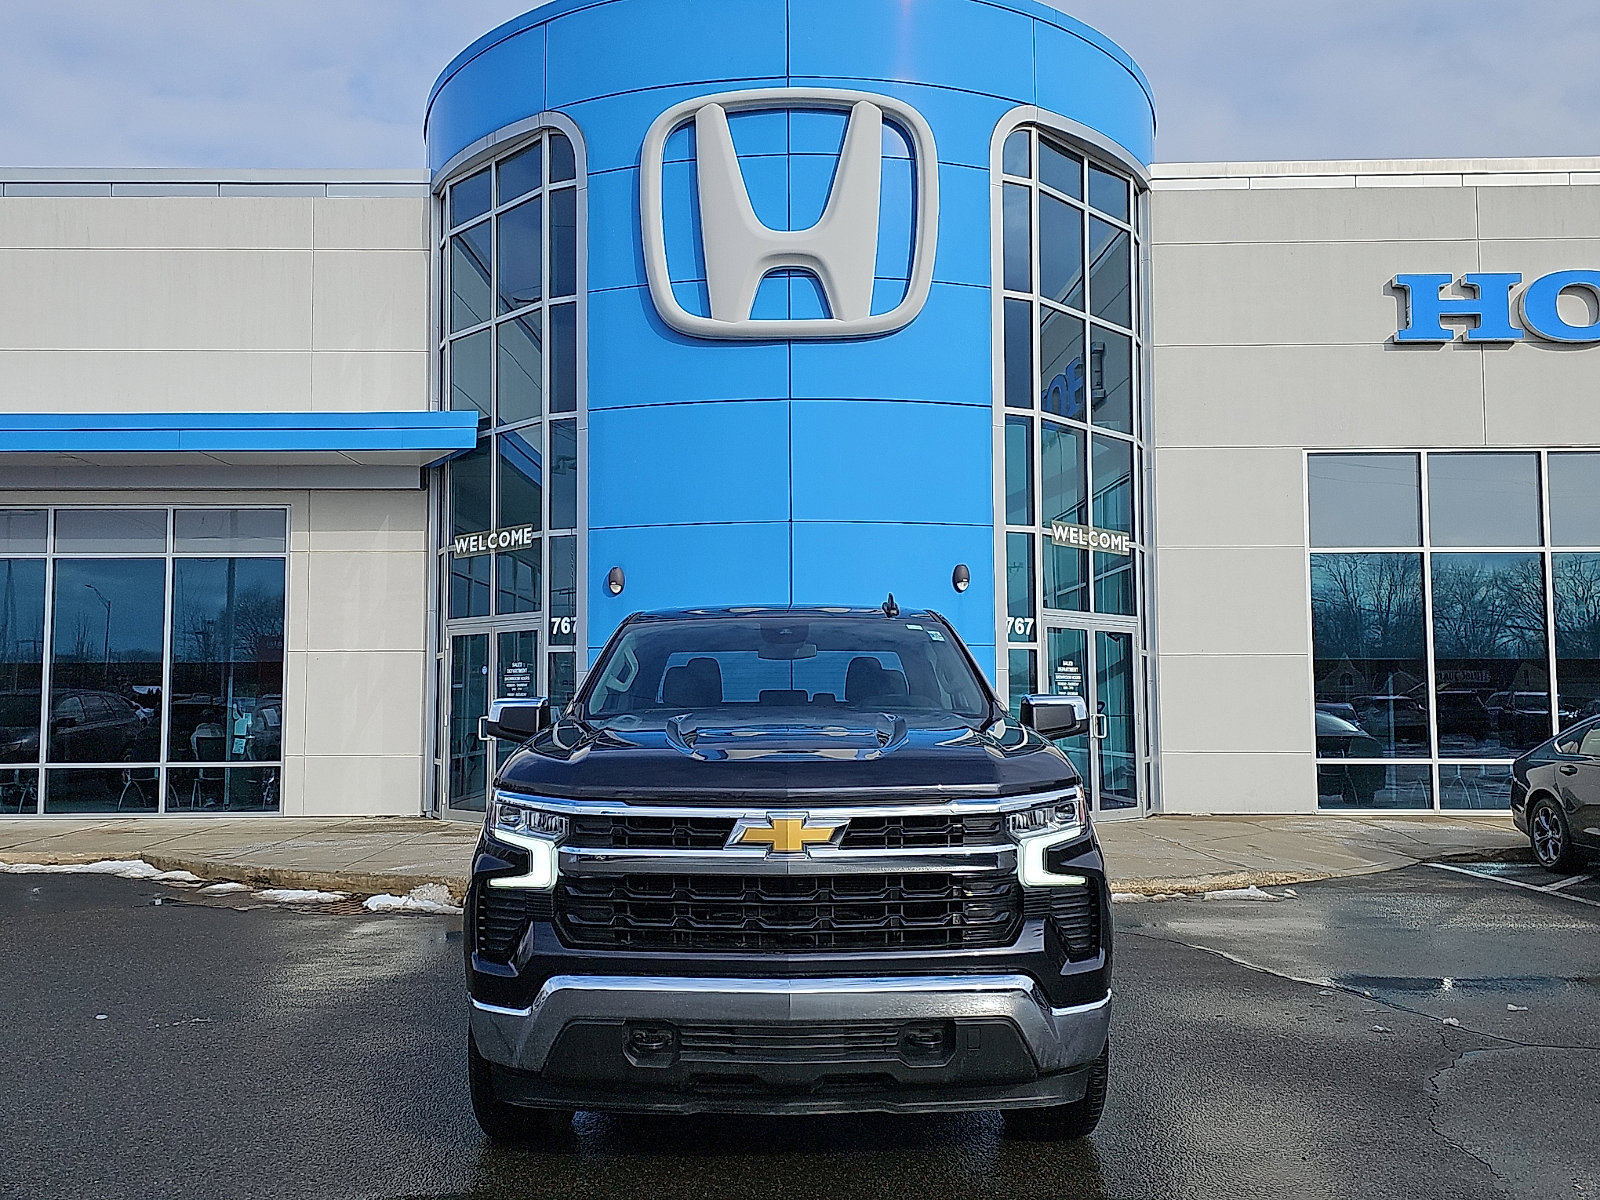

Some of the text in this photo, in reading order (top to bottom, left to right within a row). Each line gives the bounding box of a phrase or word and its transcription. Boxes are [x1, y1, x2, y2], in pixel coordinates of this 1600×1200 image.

[454, 527, 532, 554] WELCOME
[1052, 524, 1130, 552] WELCOME
[551, 616, 577, 635] 767
[1006, 616, 1035, 636] 767
